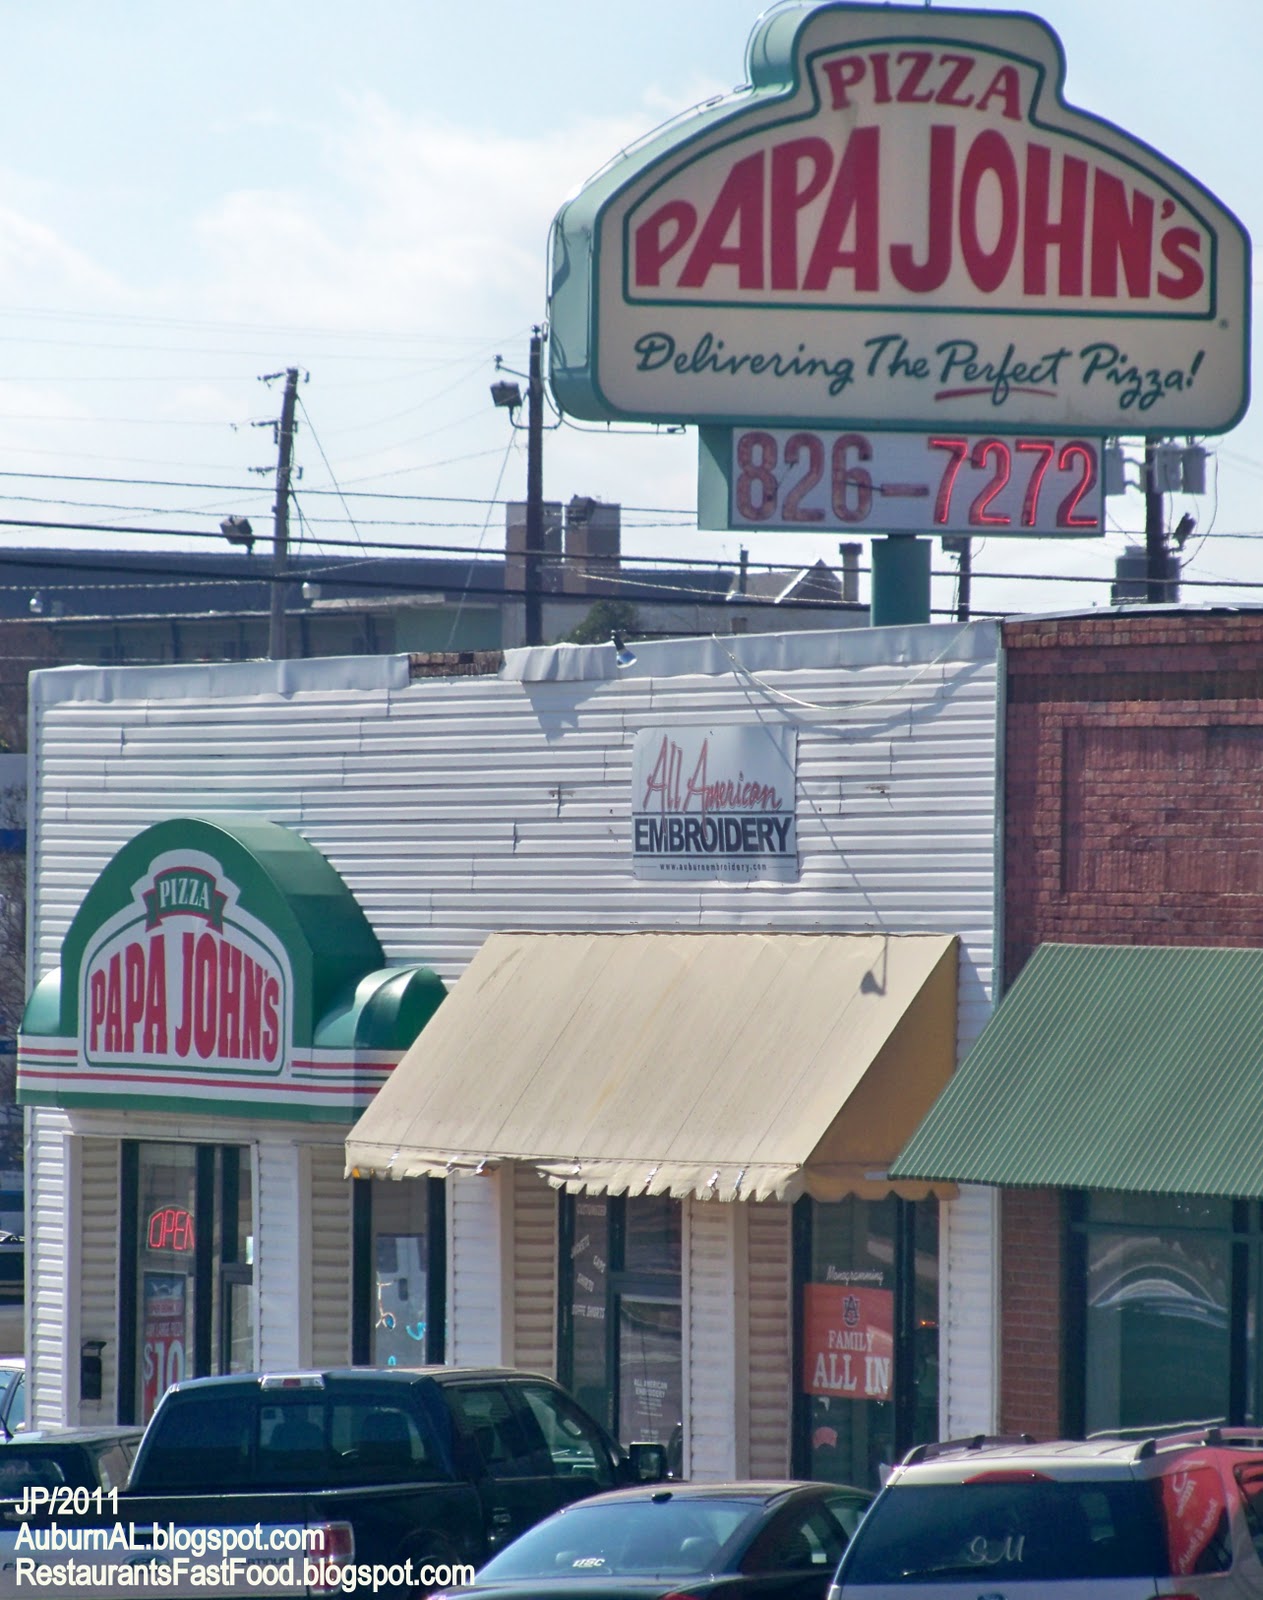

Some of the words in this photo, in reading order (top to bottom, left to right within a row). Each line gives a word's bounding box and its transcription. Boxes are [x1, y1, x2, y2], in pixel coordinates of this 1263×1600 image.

[822, 52, 1024, 120] PIZZA
[635, 125, 881, 293] PAPA
[890, 125, 1205, 300] JOHN'S
[634, 332, 855, 396] Delivering
[864, 334, 930, 379] The
[936, 340, 1072, 406] Perfect
[1080, 342, 1206, 411] Pizza!
[643, 734, 683, 836] All
[683, 738, 782, 840] American
[634, 817, 793, 853] EMBROIDERY
[159, 878, 211, 910] PIZZA
[90, 934, 168, 1055] PAPA
[175, 932, 280, 1063] JOHN'S
[150, 1209, 195, 1251] OPEN
[828, 1330, 874, 1352] FAMILY
[812, 1352, 857, 1391] ALL
[864, 1356, 891, 1395] IN
